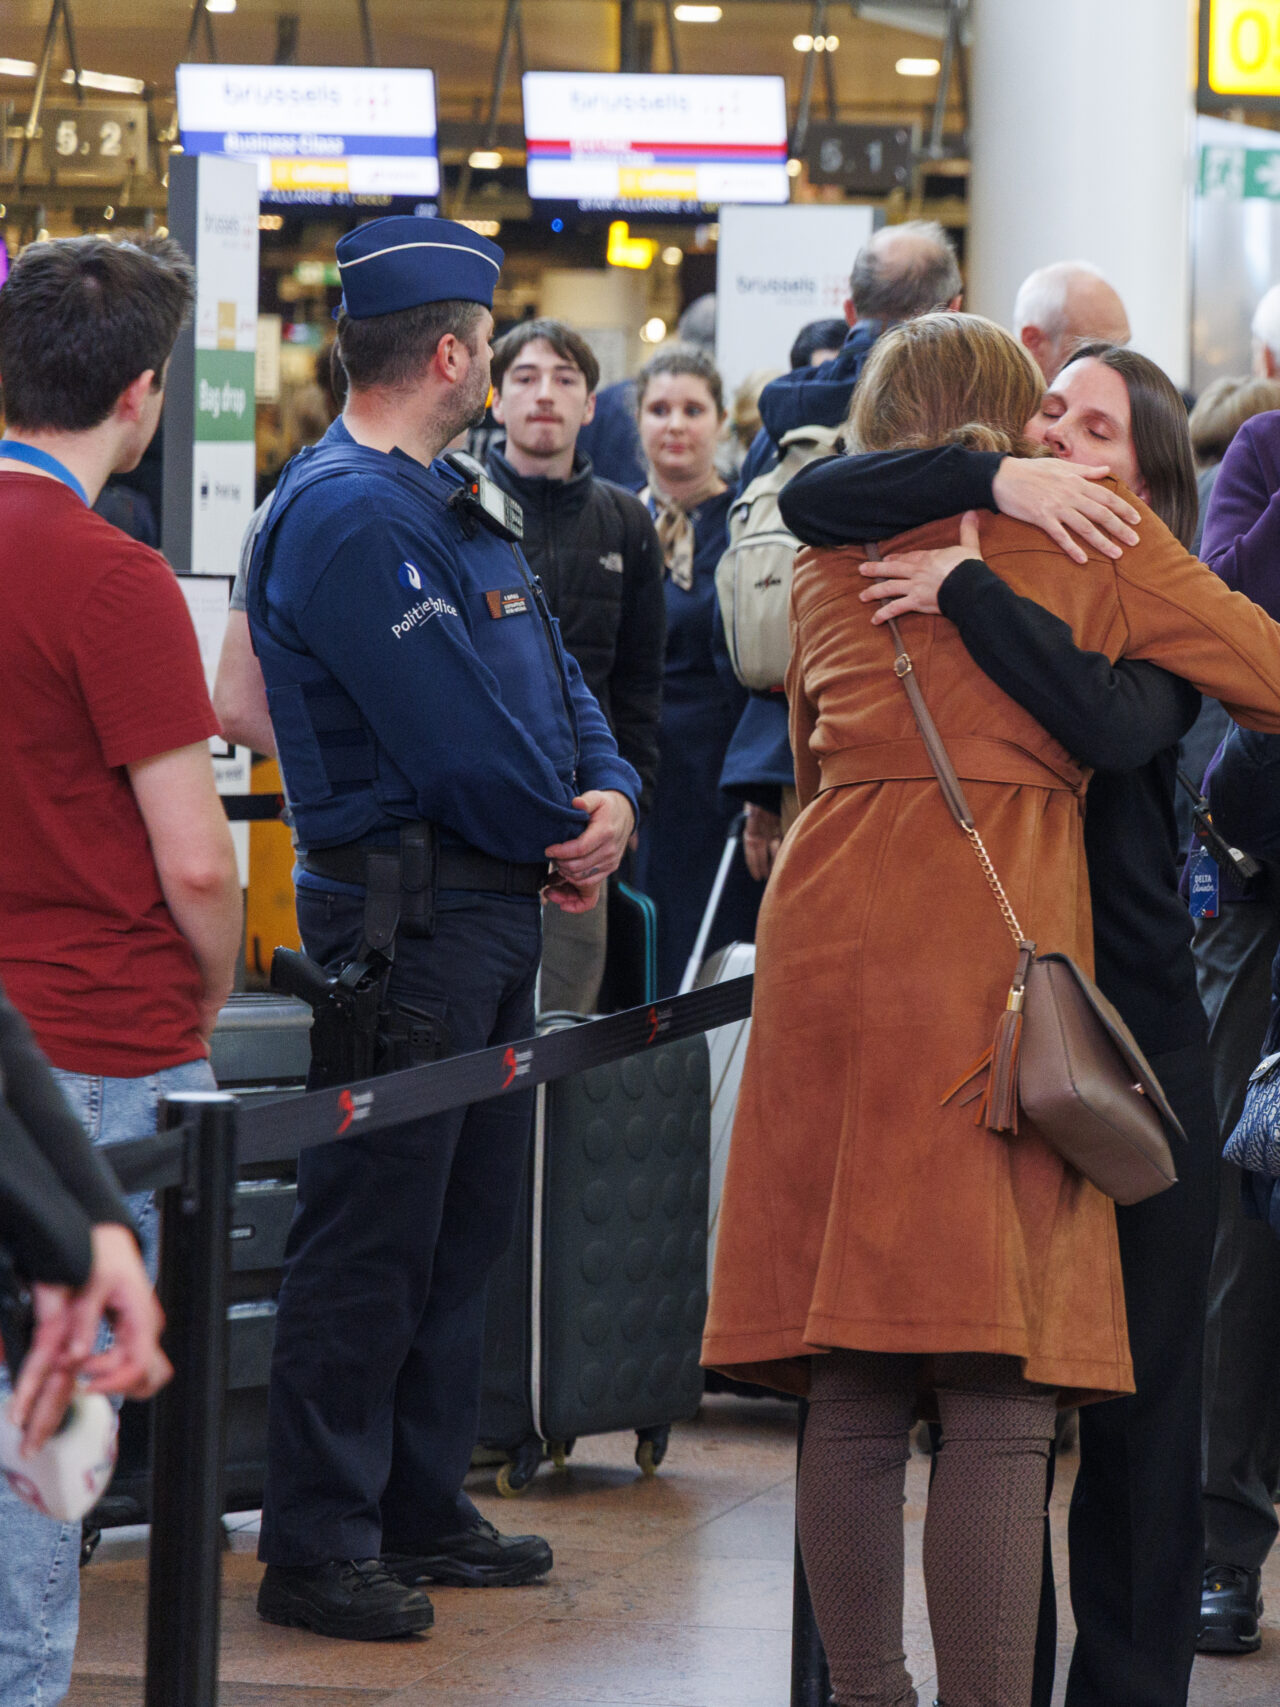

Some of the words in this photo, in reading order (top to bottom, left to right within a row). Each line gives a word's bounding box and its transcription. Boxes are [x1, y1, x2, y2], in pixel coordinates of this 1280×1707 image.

[736, 275, 817, 295] brussels
[199, 378, 220, 418] Bag
[221, 379, 246, 418] drop
[391, 600, 433, 639] Politie
[1194, 874, 1212, 883] DELTA
